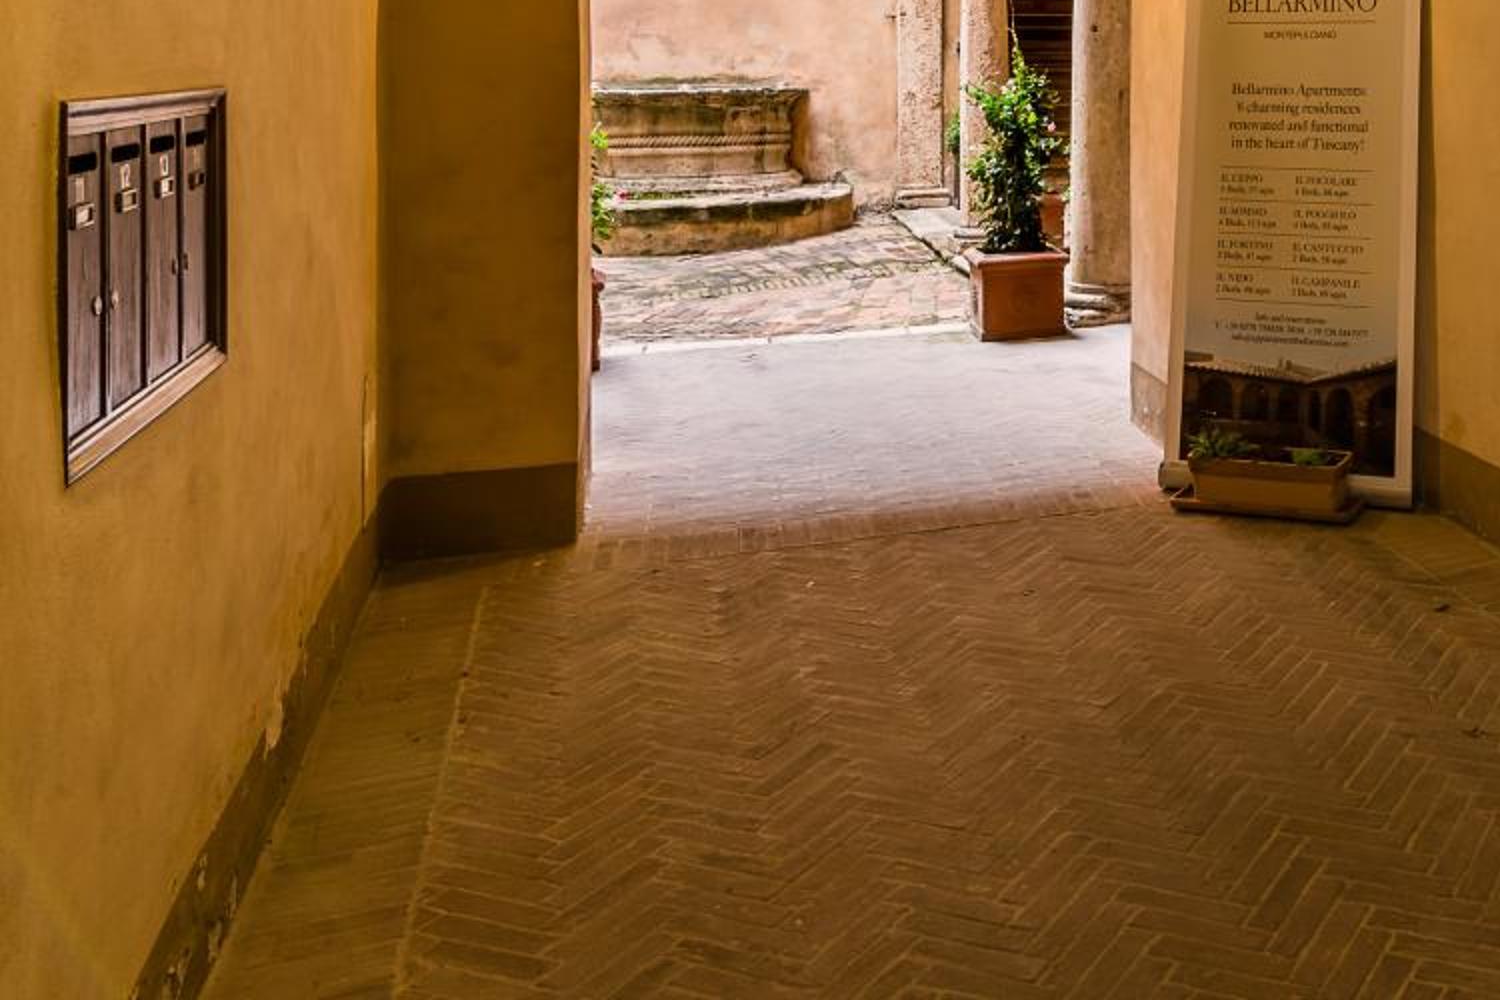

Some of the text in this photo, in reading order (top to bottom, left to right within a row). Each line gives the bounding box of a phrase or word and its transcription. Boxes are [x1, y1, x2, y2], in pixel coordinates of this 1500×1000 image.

[1247, 101, 1300, 117] charming
[1301, 101, 1361, 115] residences
[1229, 119, 1369, 133] renovated and functional
[1231, 136, 1243, 149] in
[1244, 137, 1263, 149] the
[1265, 137, 1295, 150] heart
[1297, 137, 1309, 150] of
